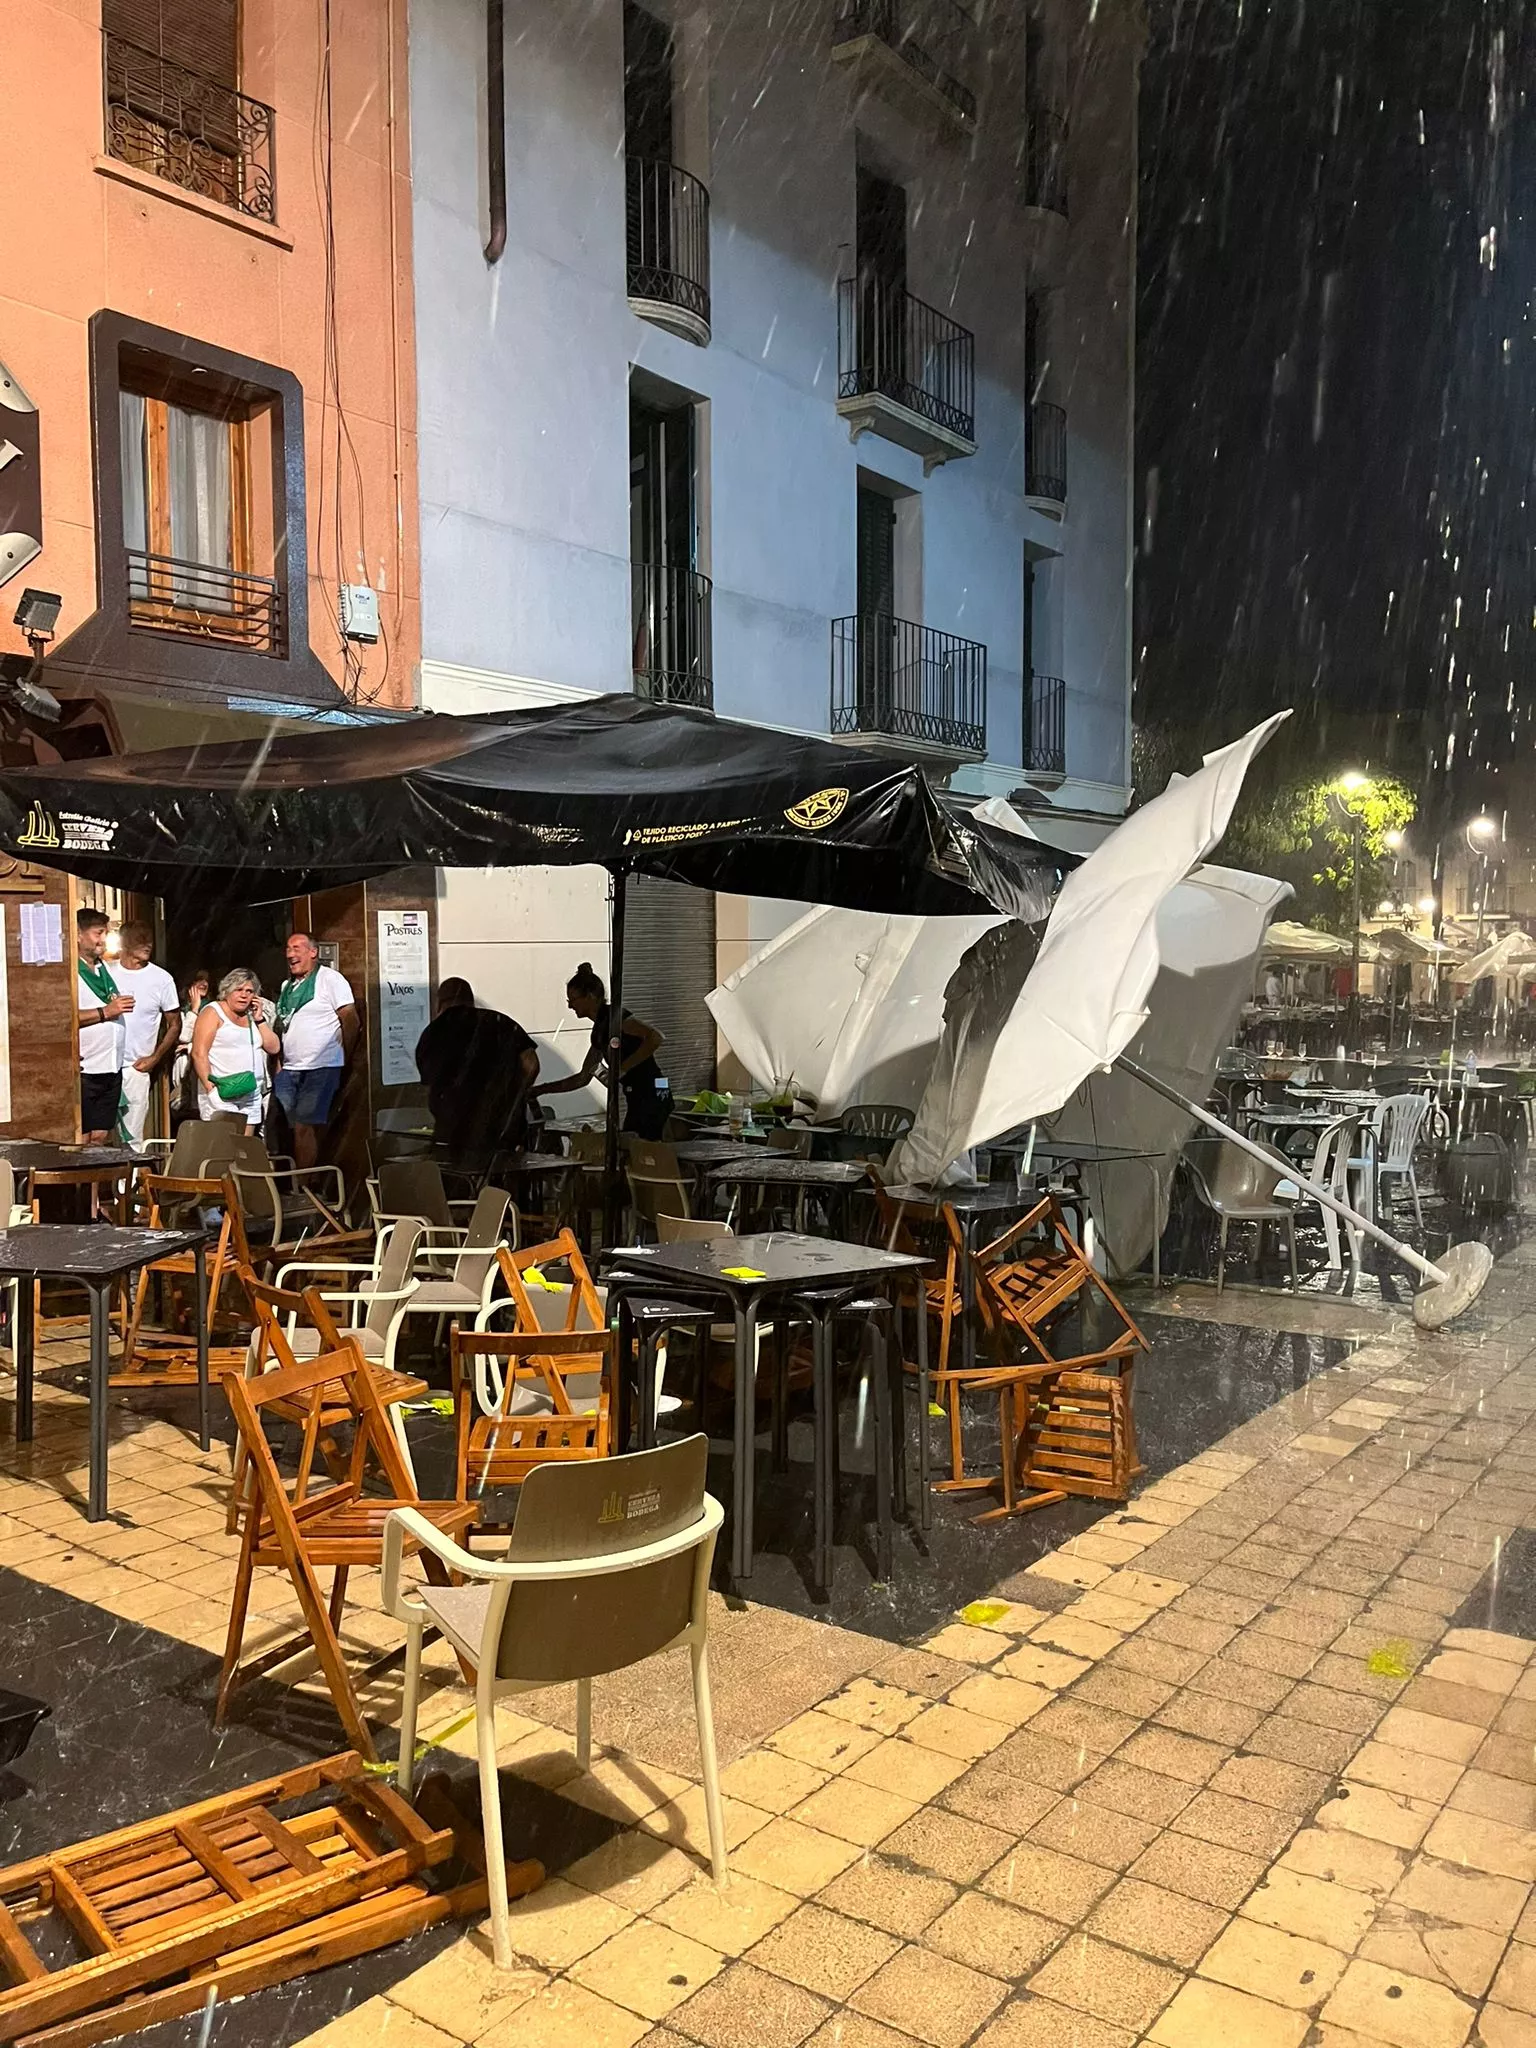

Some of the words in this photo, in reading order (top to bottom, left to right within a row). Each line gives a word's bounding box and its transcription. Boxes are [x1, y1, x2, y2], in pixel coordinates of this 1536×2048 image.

[643, 827, 666, 835] TEJIDO
[668, 823, 708, 833] RECICLADO
[641, 836, 651, 844] DE
[651, 833, 685, 843] PLÁSTICO
[62, 839, 110, 851] BODEGA
[627, 1503, 659, 1519] BODEGA
